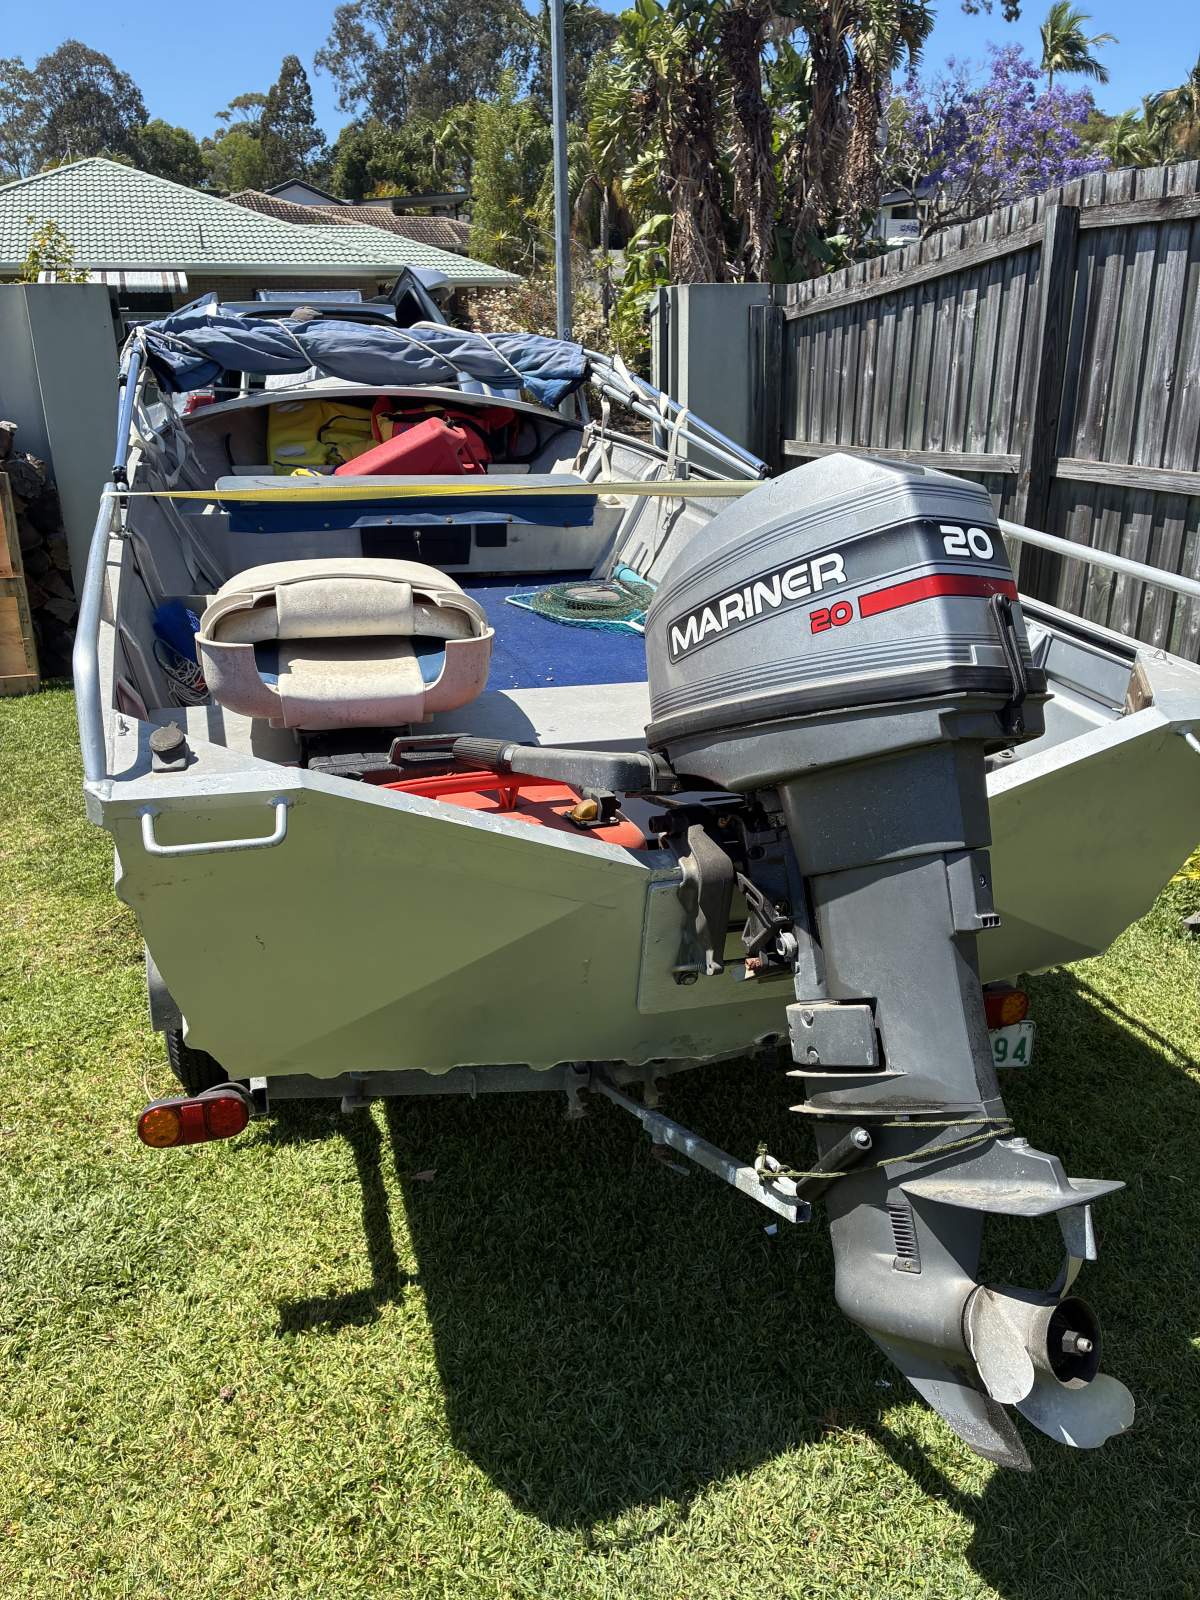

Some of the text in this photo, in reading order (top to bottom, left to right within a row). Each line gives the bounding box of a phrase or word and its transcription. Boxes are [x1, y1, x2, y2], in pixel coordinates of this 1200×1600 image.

[939, 524, 994, 560] 20
[670, 552, 848, 656] MARINER
[809, 600, 854, 635] 20
[994, 1037, 1027, 1063] 94
